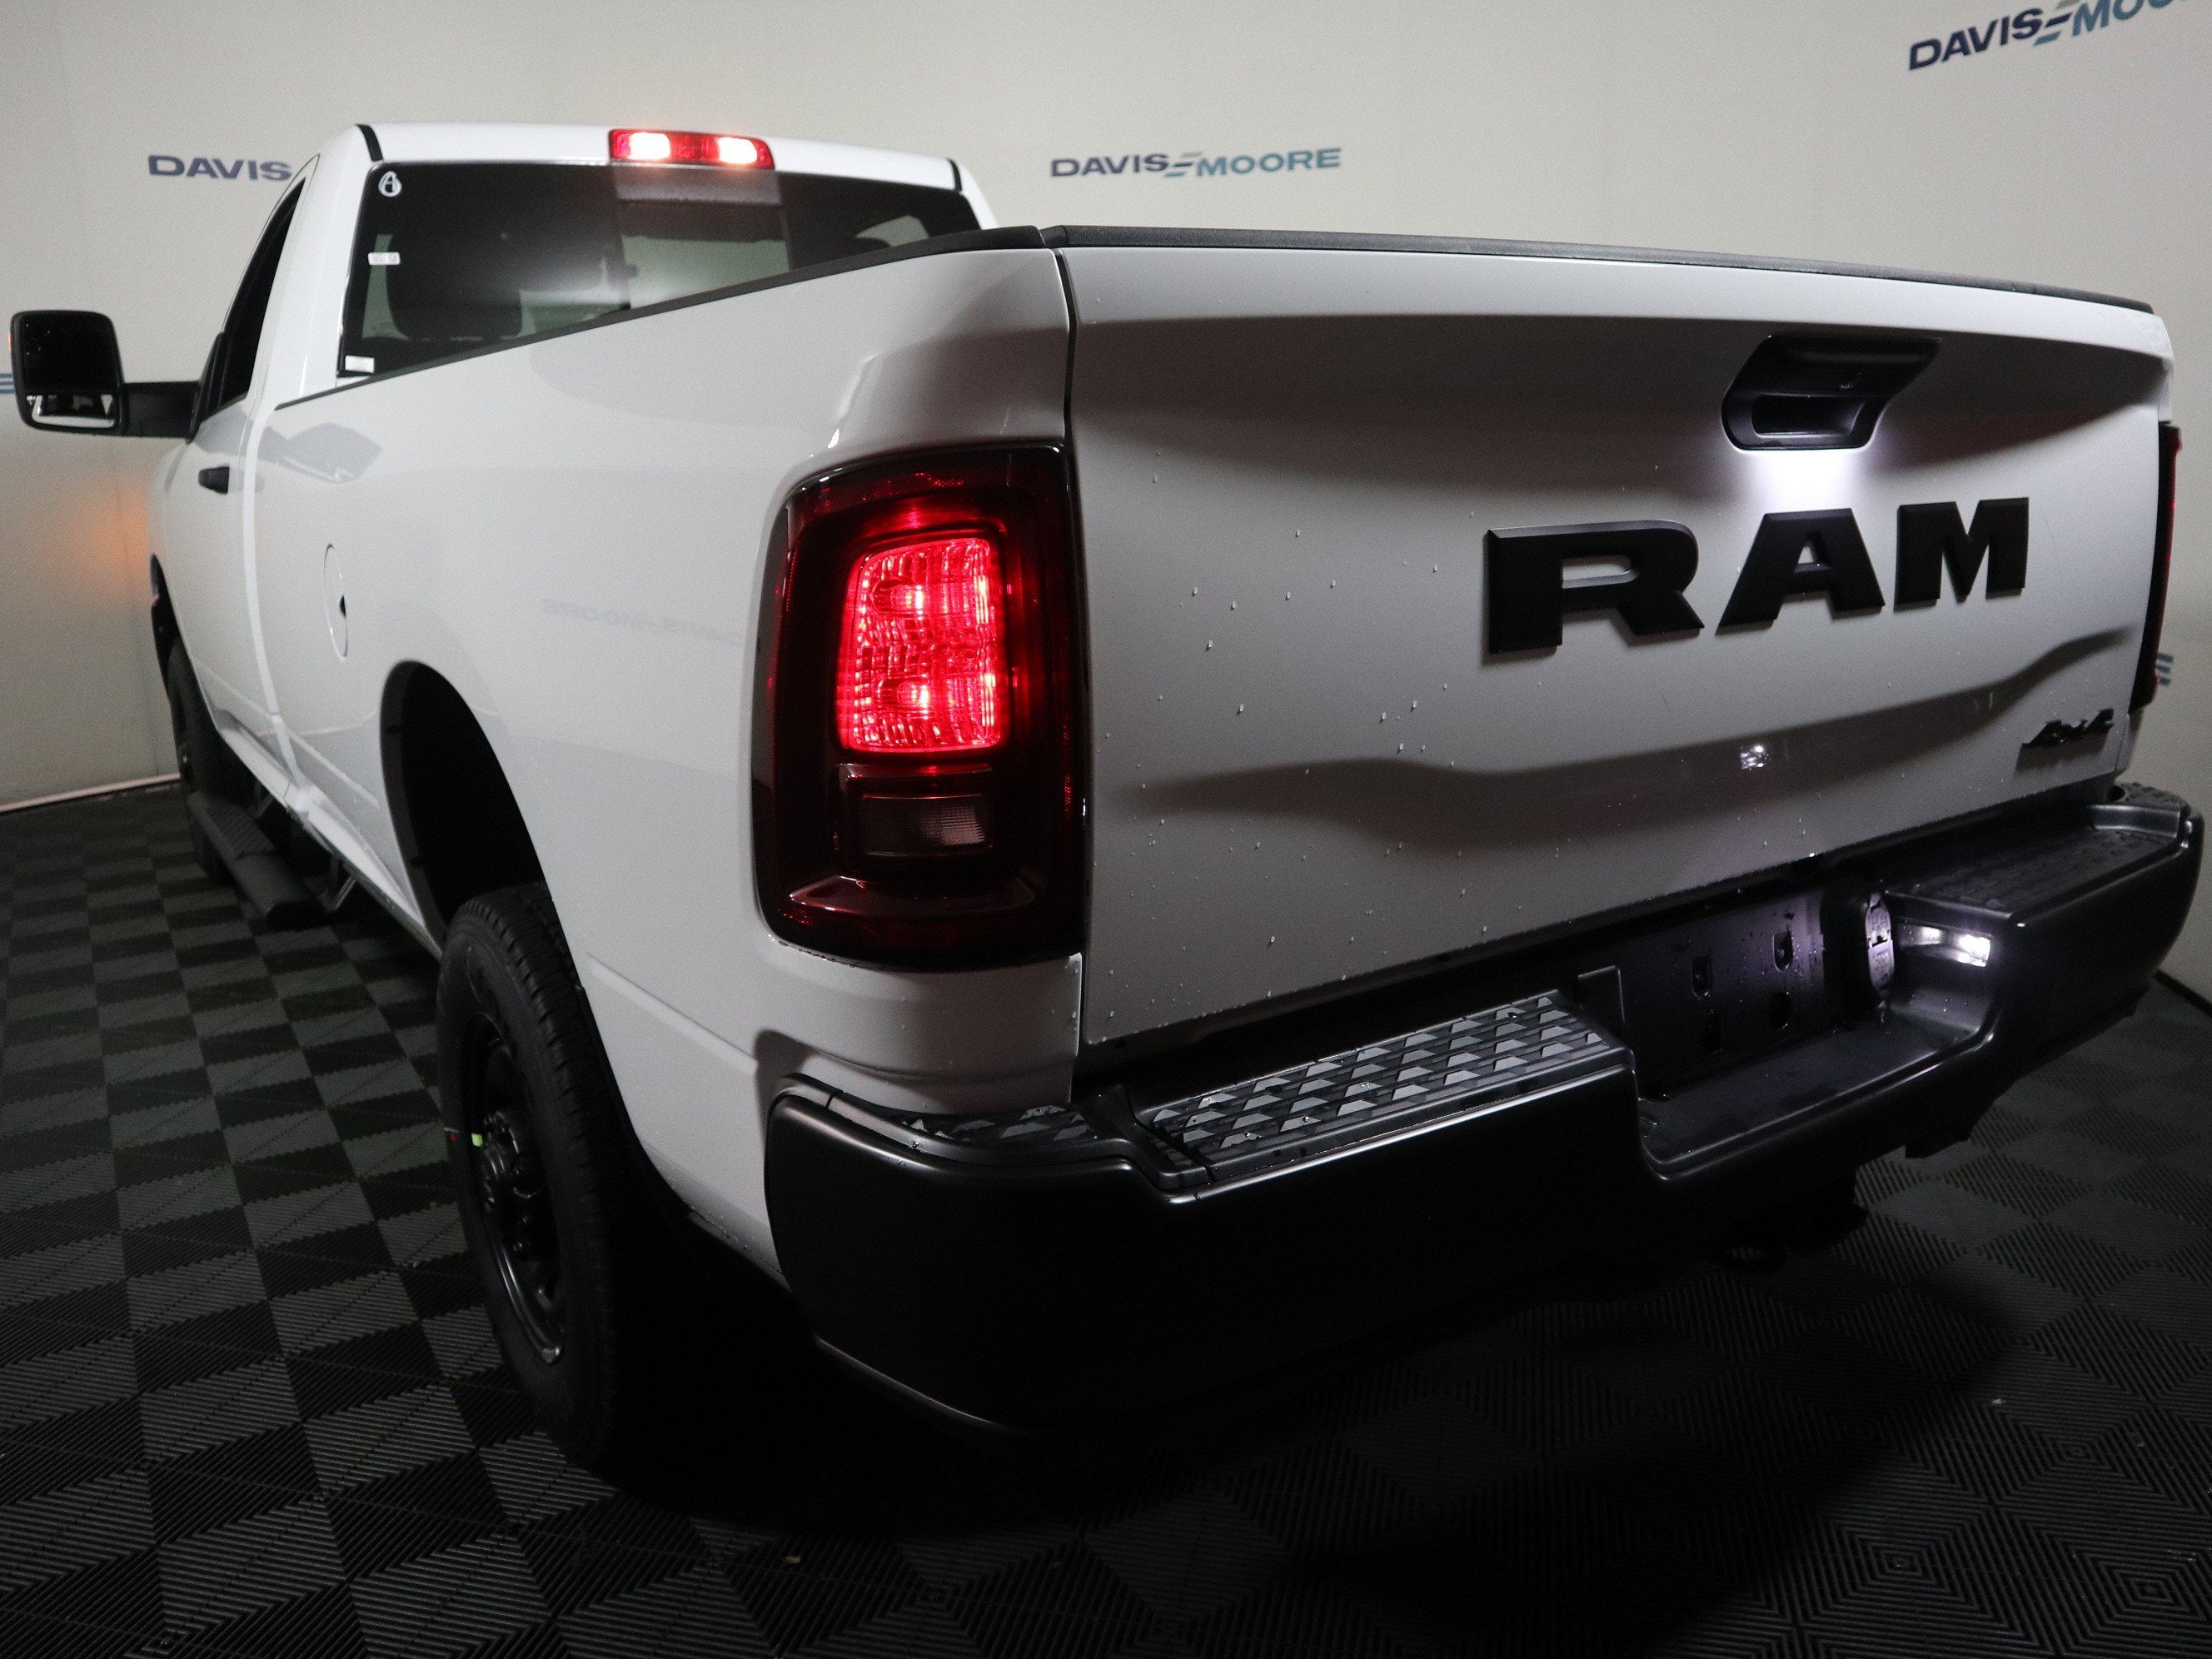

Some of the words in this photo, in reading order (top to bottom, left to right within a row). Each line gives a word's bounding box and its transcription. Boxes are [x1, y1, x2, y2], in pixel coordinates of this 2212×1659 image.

[1909, 7, 2044, 71] DAVIS
[2071, 0, 2173, 37] MO
[148, 155, 291, 181] DAVIS
[1050, 153, 1169, 177] DAVIS
[1196, 147, 1341, 177] MOORE
[1487, 497, 2030, 655] RAM
